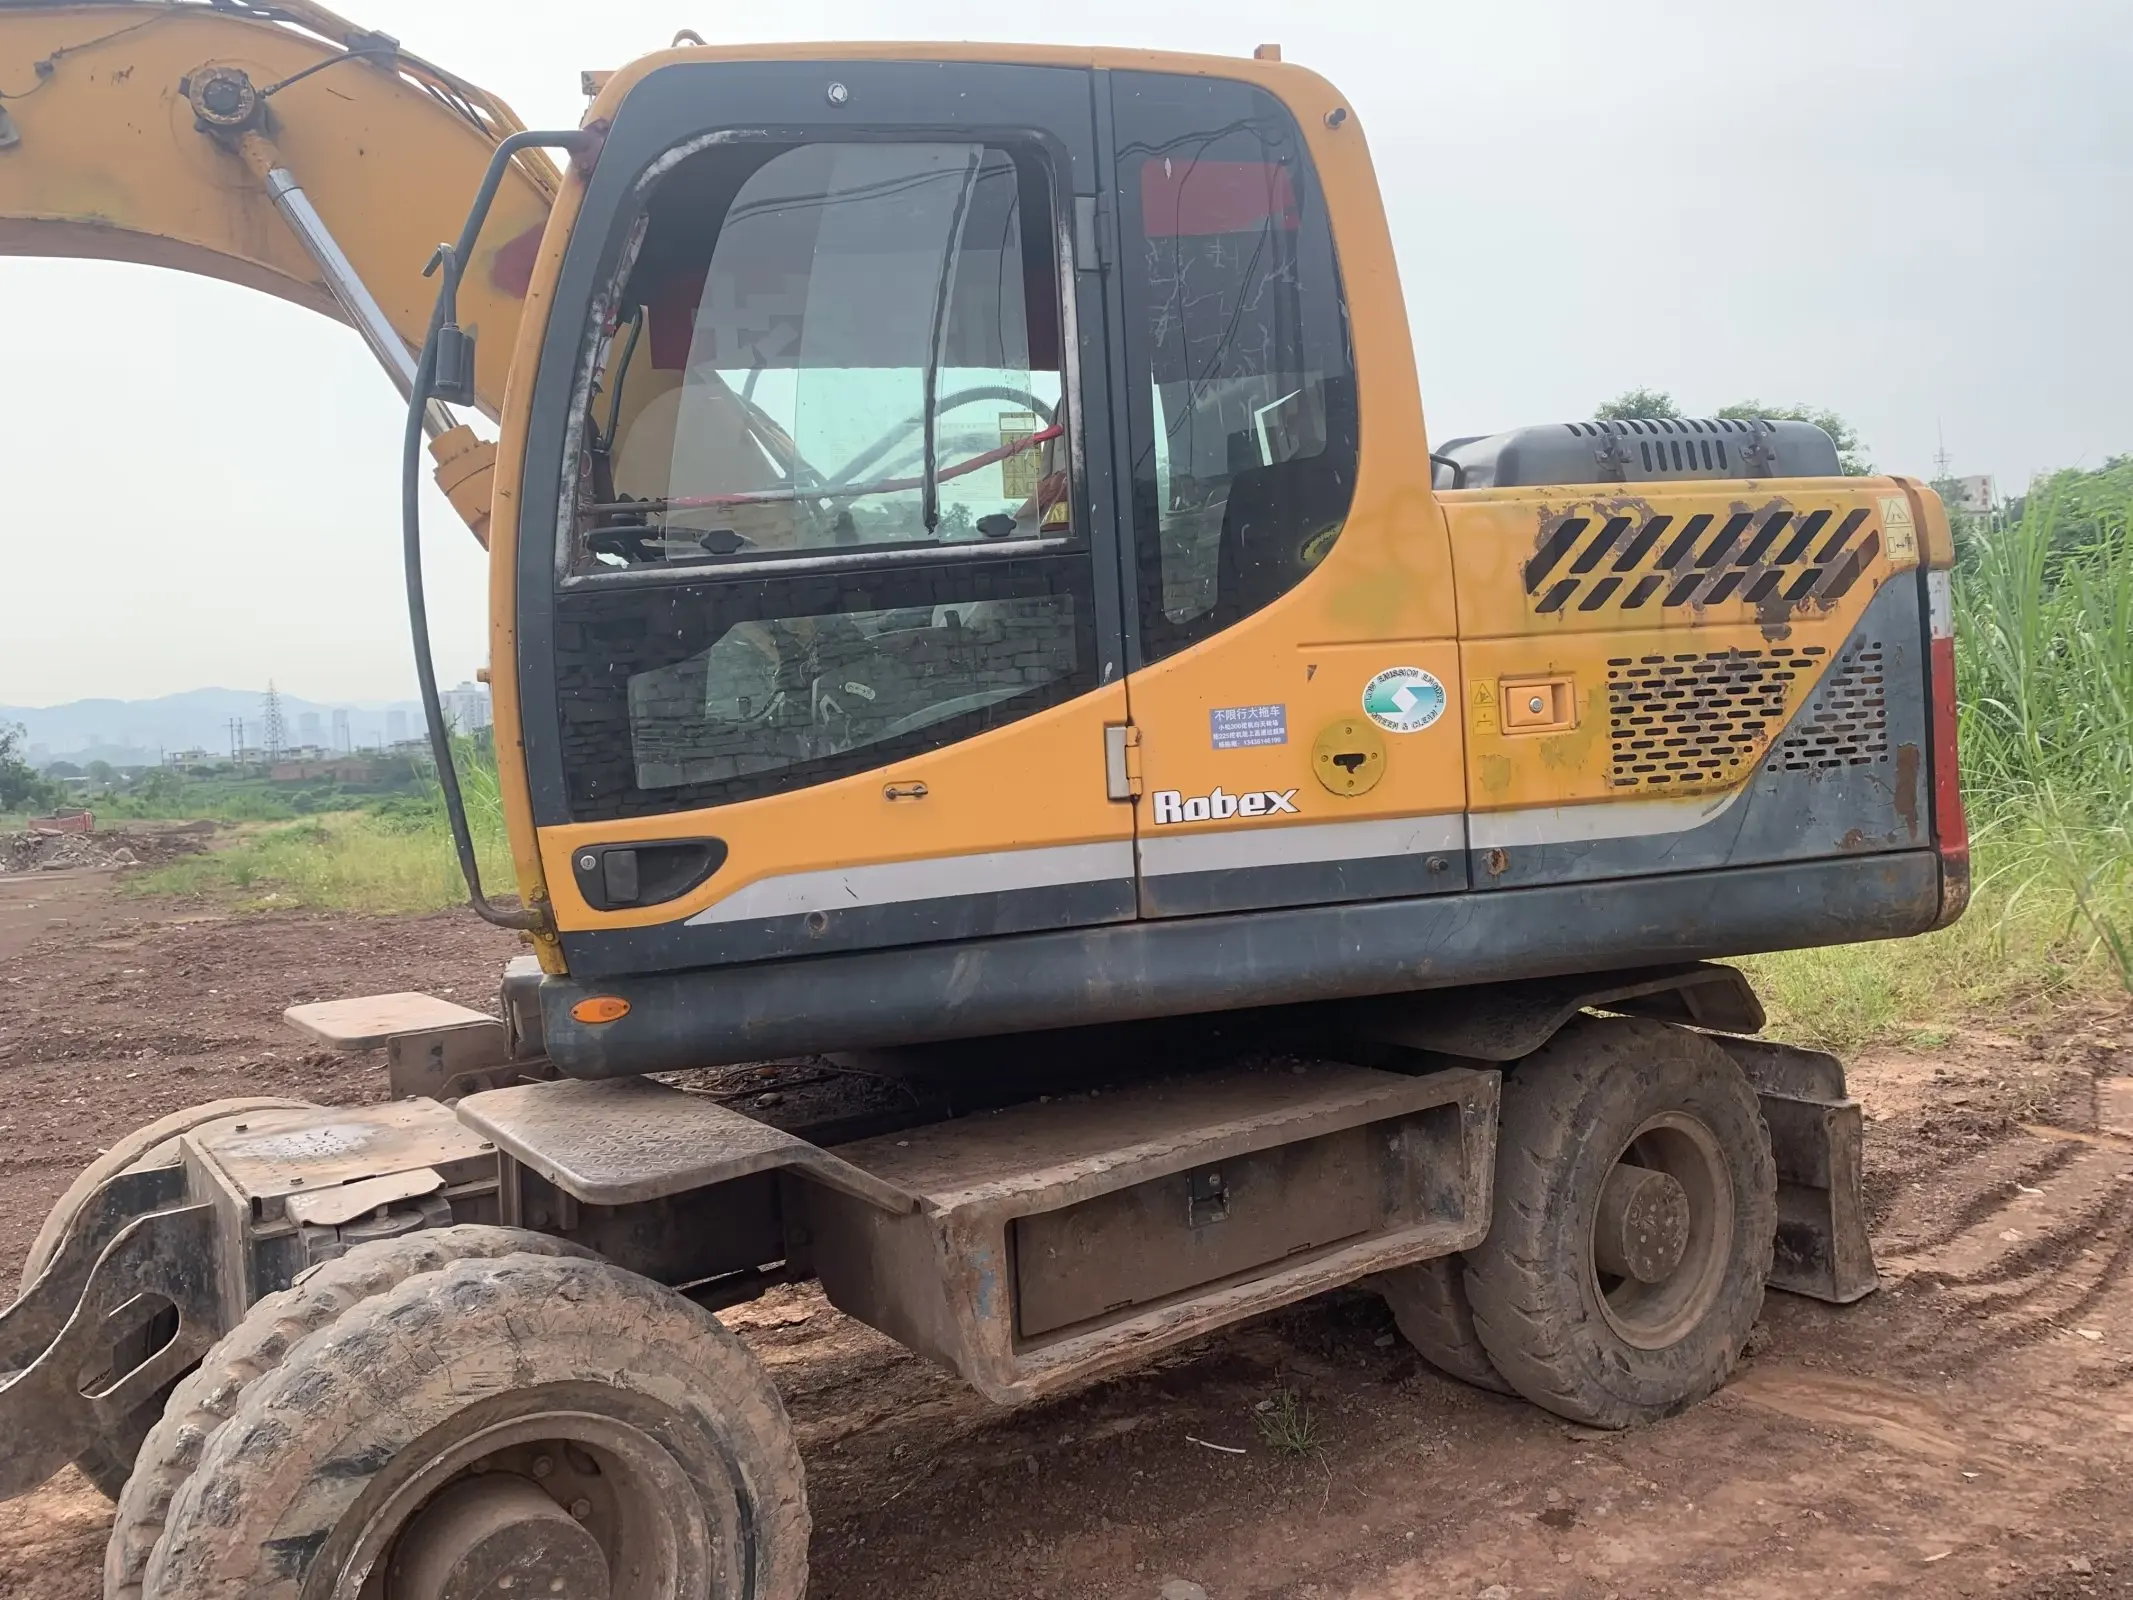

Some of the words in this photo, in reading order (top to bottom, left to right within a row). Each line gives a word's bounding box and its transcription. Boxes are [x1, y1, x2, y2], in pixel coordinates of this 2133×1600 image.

[1365, 681, 1376, 702] LOW
[1377, 669, 1418, 683] EMISSION
[1421, 674, 1444, 704] ENGINE
[1215, 706, 1280, 721] 不限行大拖车
[1371, 712, 1399, 730] GREEN
[1412, 710, 1438, 729] CLEAN
[1152, 786, 1301, 825] Robex
